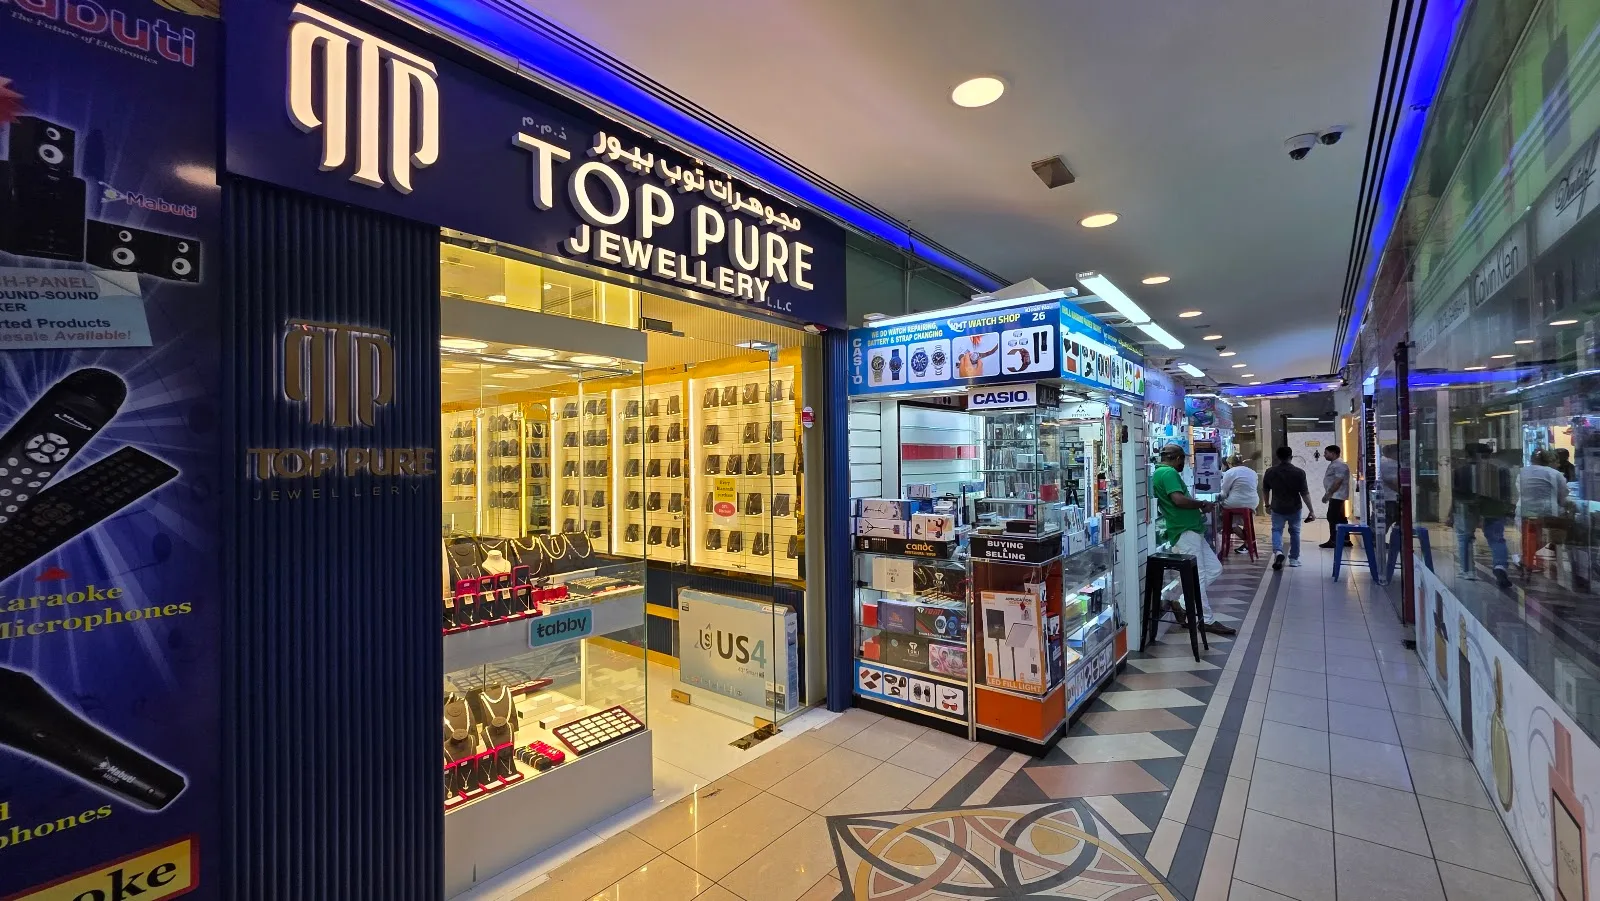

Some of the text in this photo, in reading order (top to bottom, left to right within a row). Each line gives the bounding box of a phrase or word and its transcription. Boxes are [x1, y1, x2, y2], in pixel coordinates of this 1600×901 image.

[10, 10, 159, 66] The Future of Electronics
[12, 0, 196, 67] abuti
[588, 130, 654, 174] بيور
[654, 159, 705, 194] توب
[126, 191, 198, 219] Mabuti
[513, 131, 814, 291] TOP PURE
[565, 223, 770, 303] JEWELLERY
[1473, 236, 1519, 307] Calvin Klein
[0, 276, 95, 289] H-PANEL
[767, 296, 792, 312] L.L.C
[37, 318, 111, 329] Products
[968, 317, 997, 328] WATCH
[998, 313, 1021, 324] SHOP
[1032, 312, 1045, 321] 26
[54, 330, 132, 341] Available!
[867, 337, 890, 347] BATTERY
[895, 334, 913, 344] STRAP
[913, 329, 943, 341] CHANGING
[871, 331, 881, 339] WE
[888, 327, 907, 336] WATCH
[907, 322, 938, 334] REPAIRING,
[852, 338, 863, 385] CASIO
[973, 390, 1028, 404] CASIO
[246, 447, 437, 480] TOP PURE
[253, 485, 421, 501] JEWELLERY
[987, 540, 1024, 550] BUYING
[985, 550, 1026, 560] SELLING
[536, 615, 587, 638] tabby
[716, 629, 767, 669] US4
[986, 677, 1042, 693] LED FILL LIGHT
